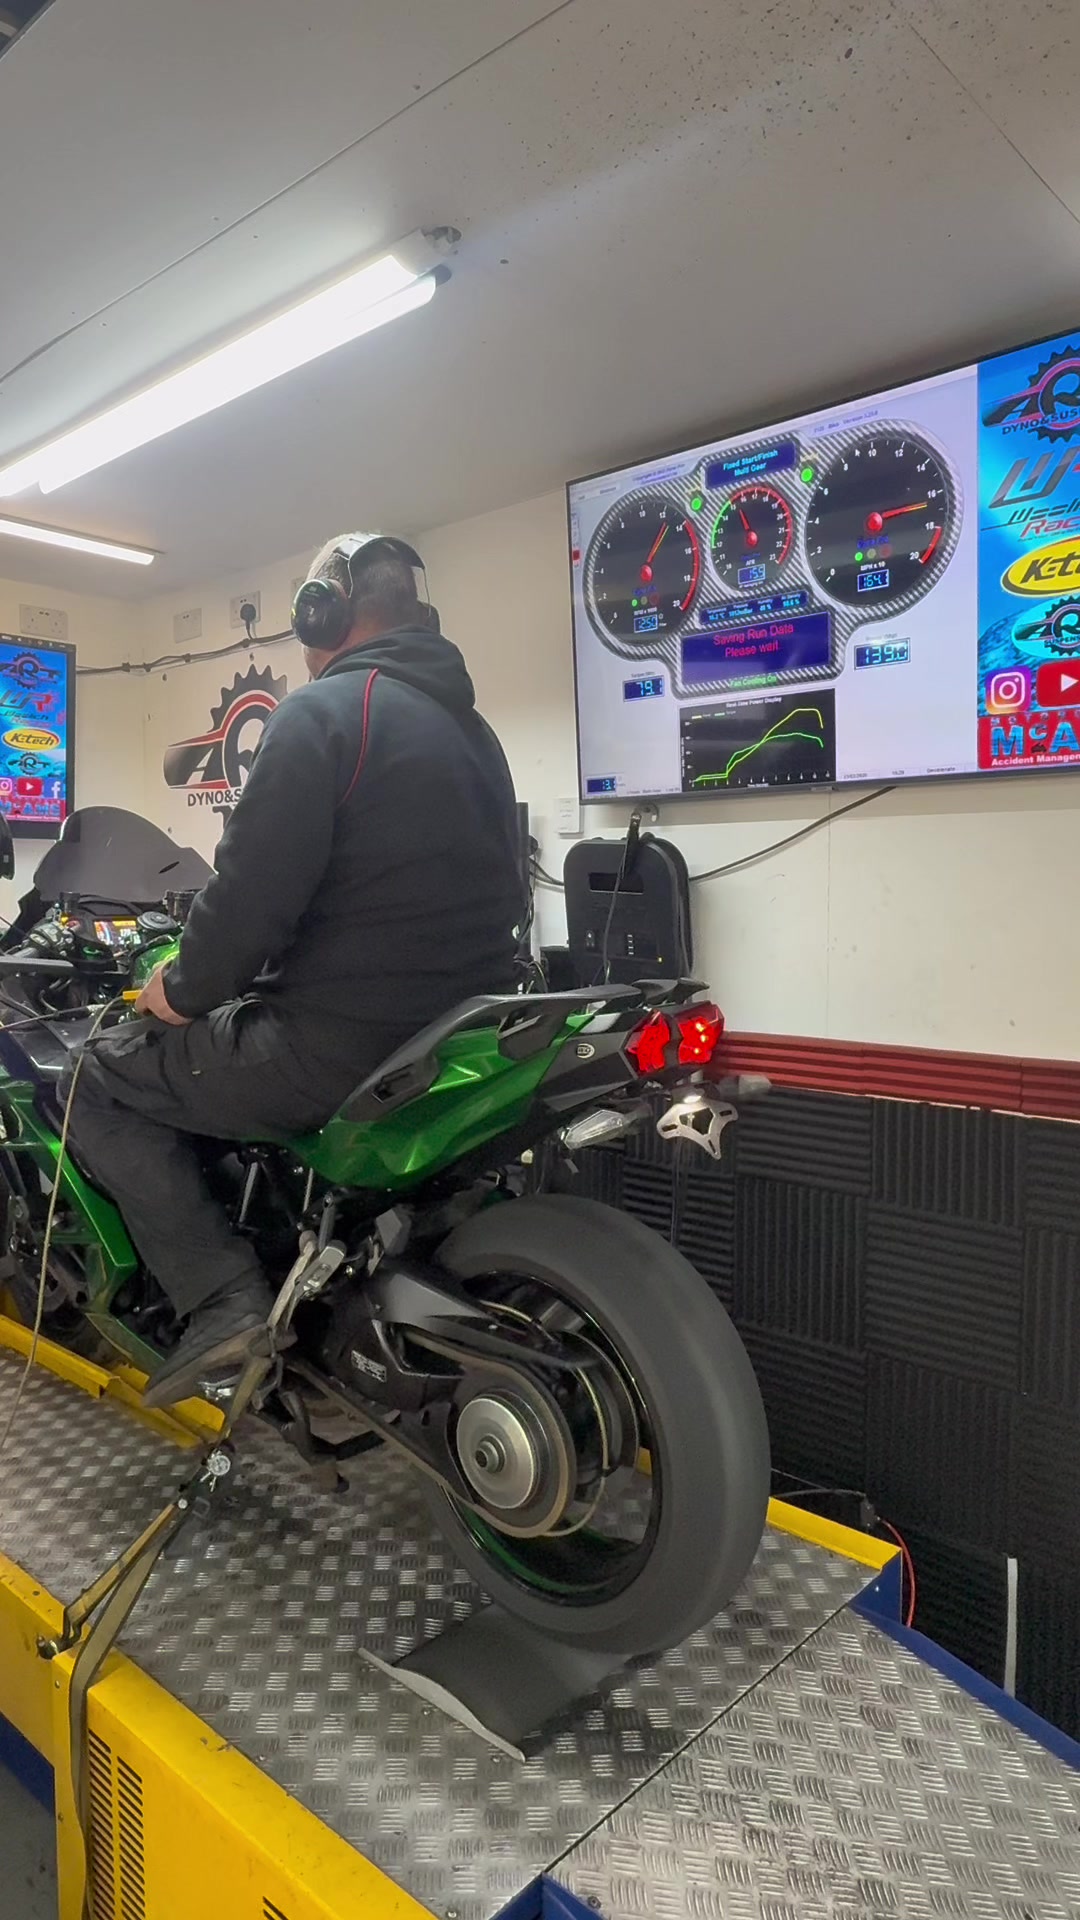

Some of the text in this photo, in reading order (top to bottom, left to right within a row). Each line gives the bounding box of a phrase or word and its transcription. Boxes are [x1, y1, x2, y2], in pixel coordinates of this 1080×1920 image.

[751, 463, 766, 472] Gear
[713, 624, 794, 646] Saving Run Data
[725, 640, 778, 657] Please wait
[992, 756, 1034, 766] Accident
